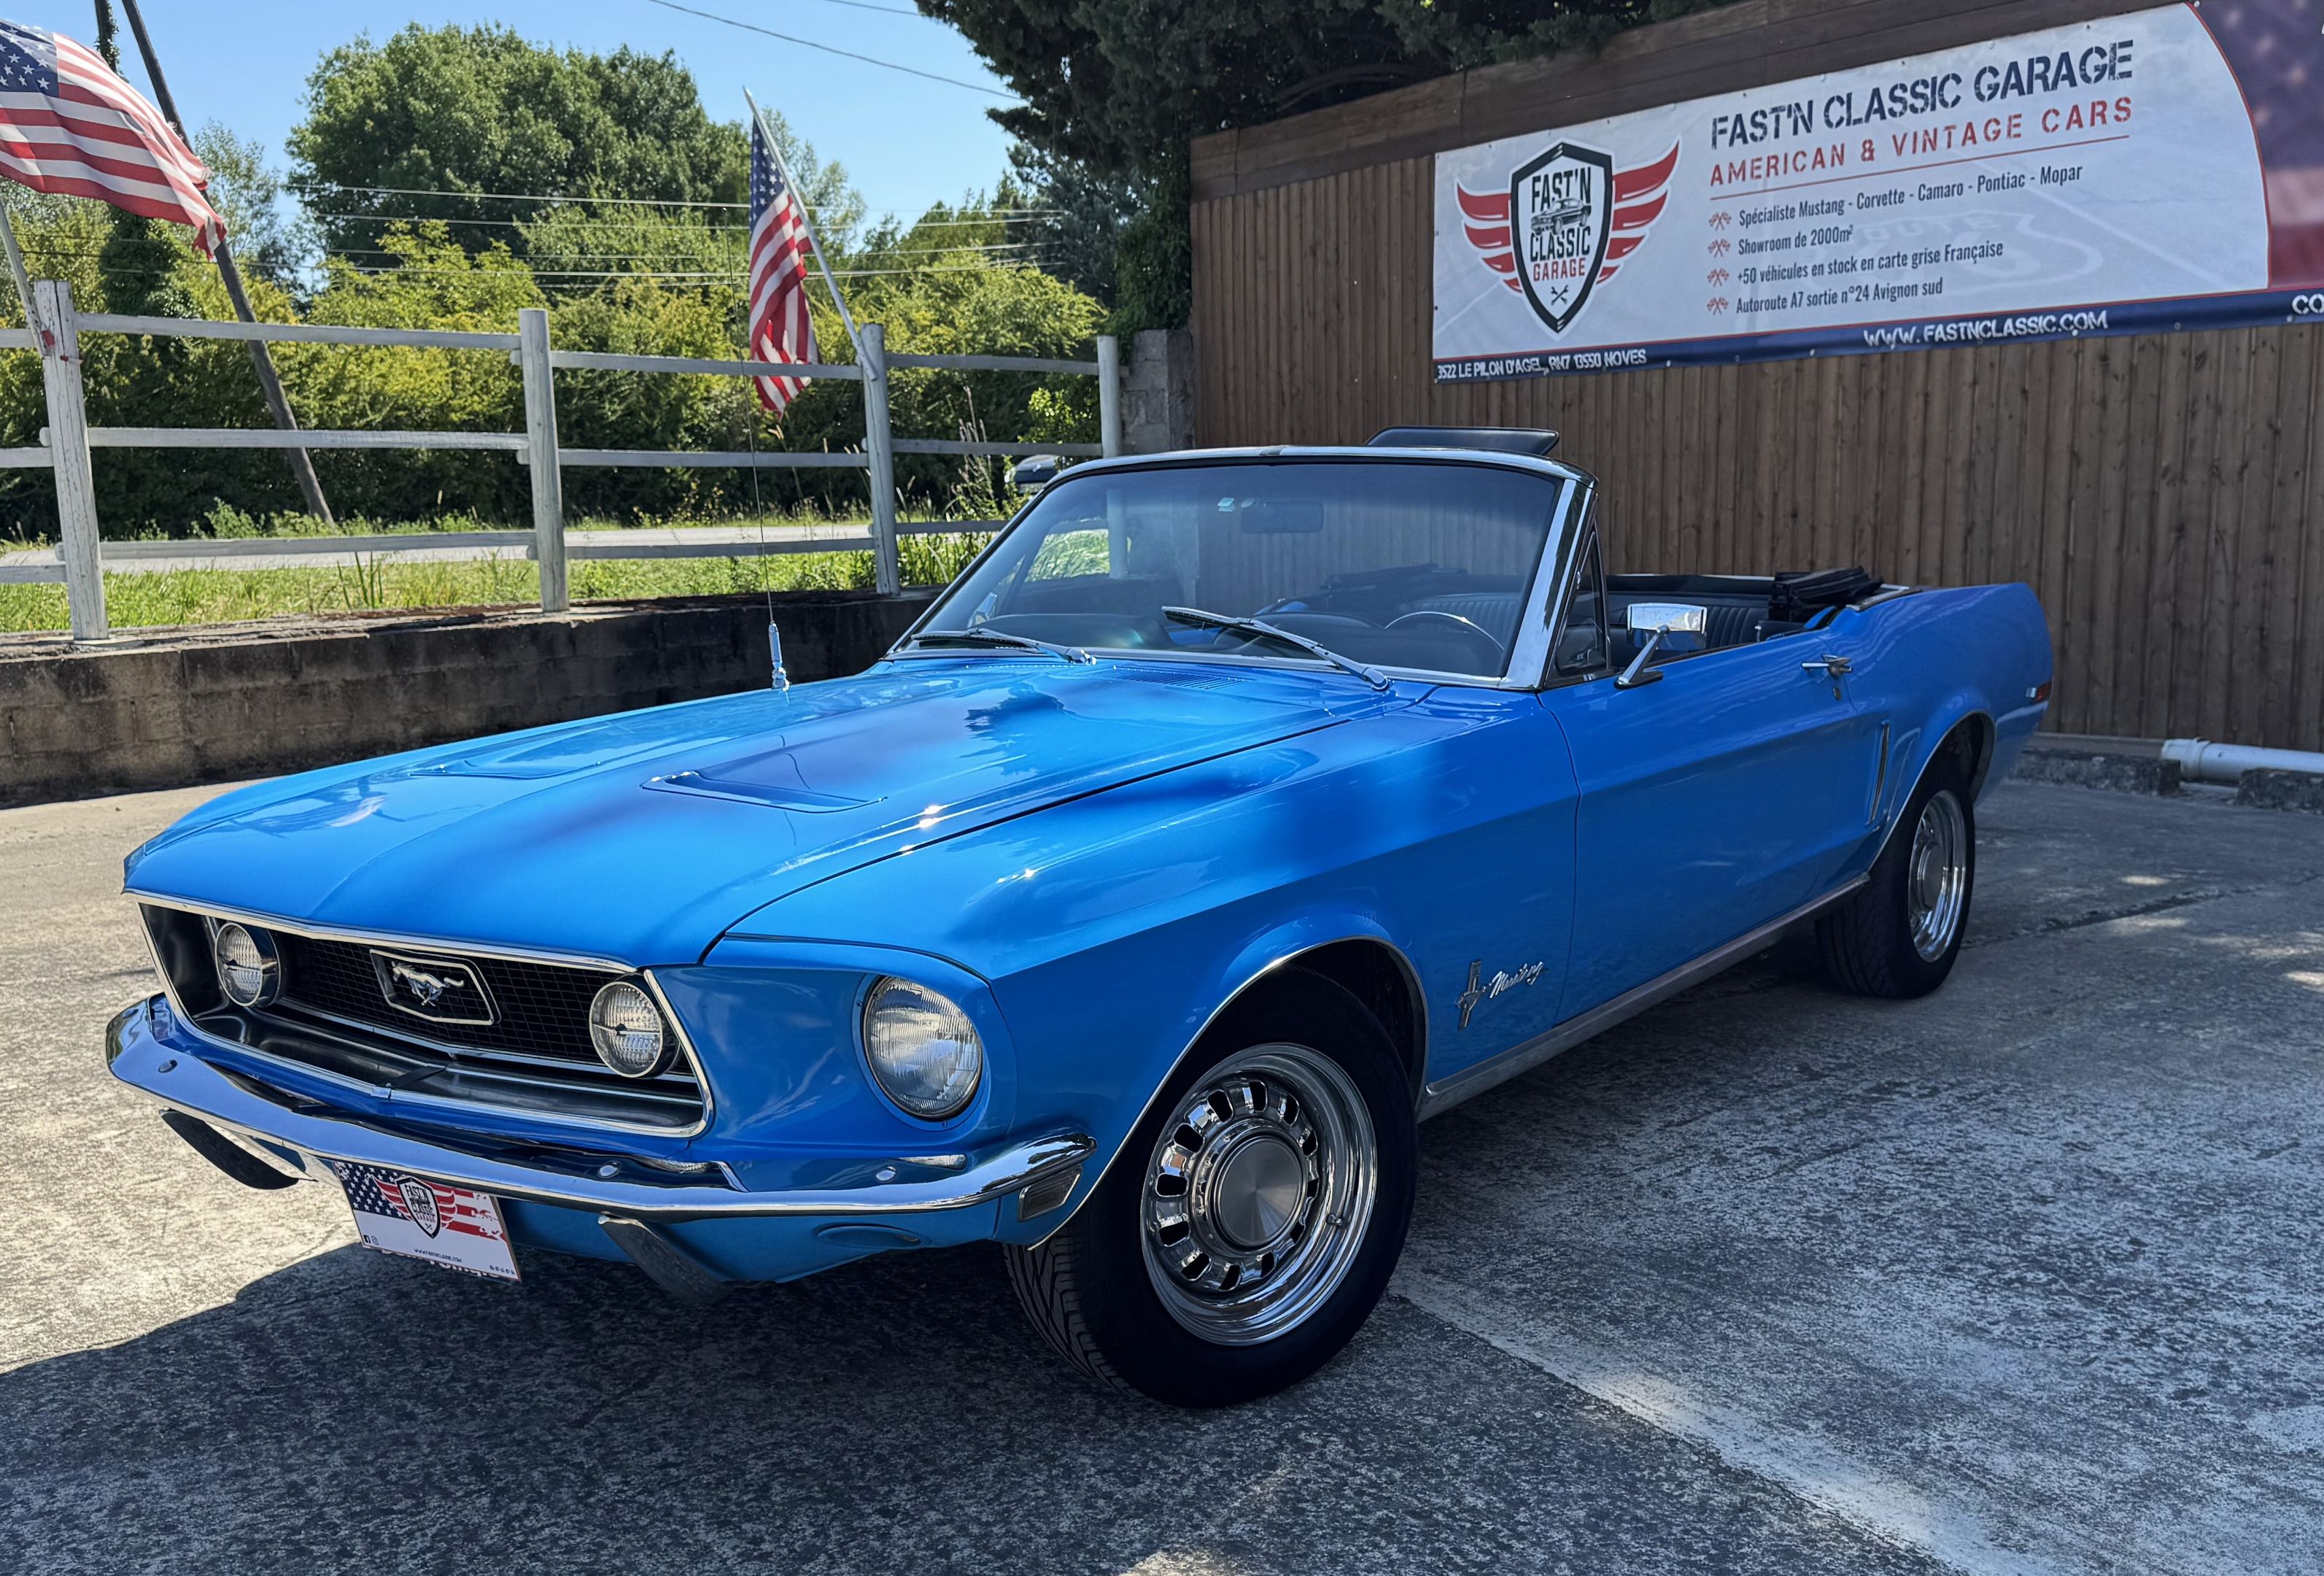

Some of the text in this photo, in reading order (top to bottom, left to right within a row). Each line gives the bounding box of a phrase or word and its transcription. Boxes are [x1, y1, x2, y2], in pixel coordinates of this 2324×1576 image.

[1711, 39, 2134, 150] FAST'N CLASSIC GARAGE
[1709, 96, 2132, 187] AMERICAN & VINTAGE CARS
[1531, 166, 1592, 214] FAST'N
[1738, 204, 1796, 228] Spécialiste
[1799, 198, 1845, 218] Mustang
[1856, 188, 1905, 210] Corvette
[1918, 182, 1964, 201] Camaro
[1977, 171, 2026, 193] Pontiac
[2040, 165, 2083, 187] Mopar
[1529, 225, 1592, 263] CLASSIC
[1737, 240, 2004, 285] +50 véhicules en stock en carte grise Française
[1738, 236, 1792, 255] Showroom
[1794, 231, 1807, 248] de
[1533, 258, 1587, 282] GARAGE
[1736, 293, 1787, 314] Autoroute
[1790, 291, 1804, 309] A7
[1806, 287, 1837, 308] sortie
[1872, 282, 1918, 303] Avignon
[1921, 277, 1943, 296] sud
[1458, 363, 1472, 378] LE
[1549, 354, 1571, 371] RN7
[1604, 348, 1648, 368] NOVES
